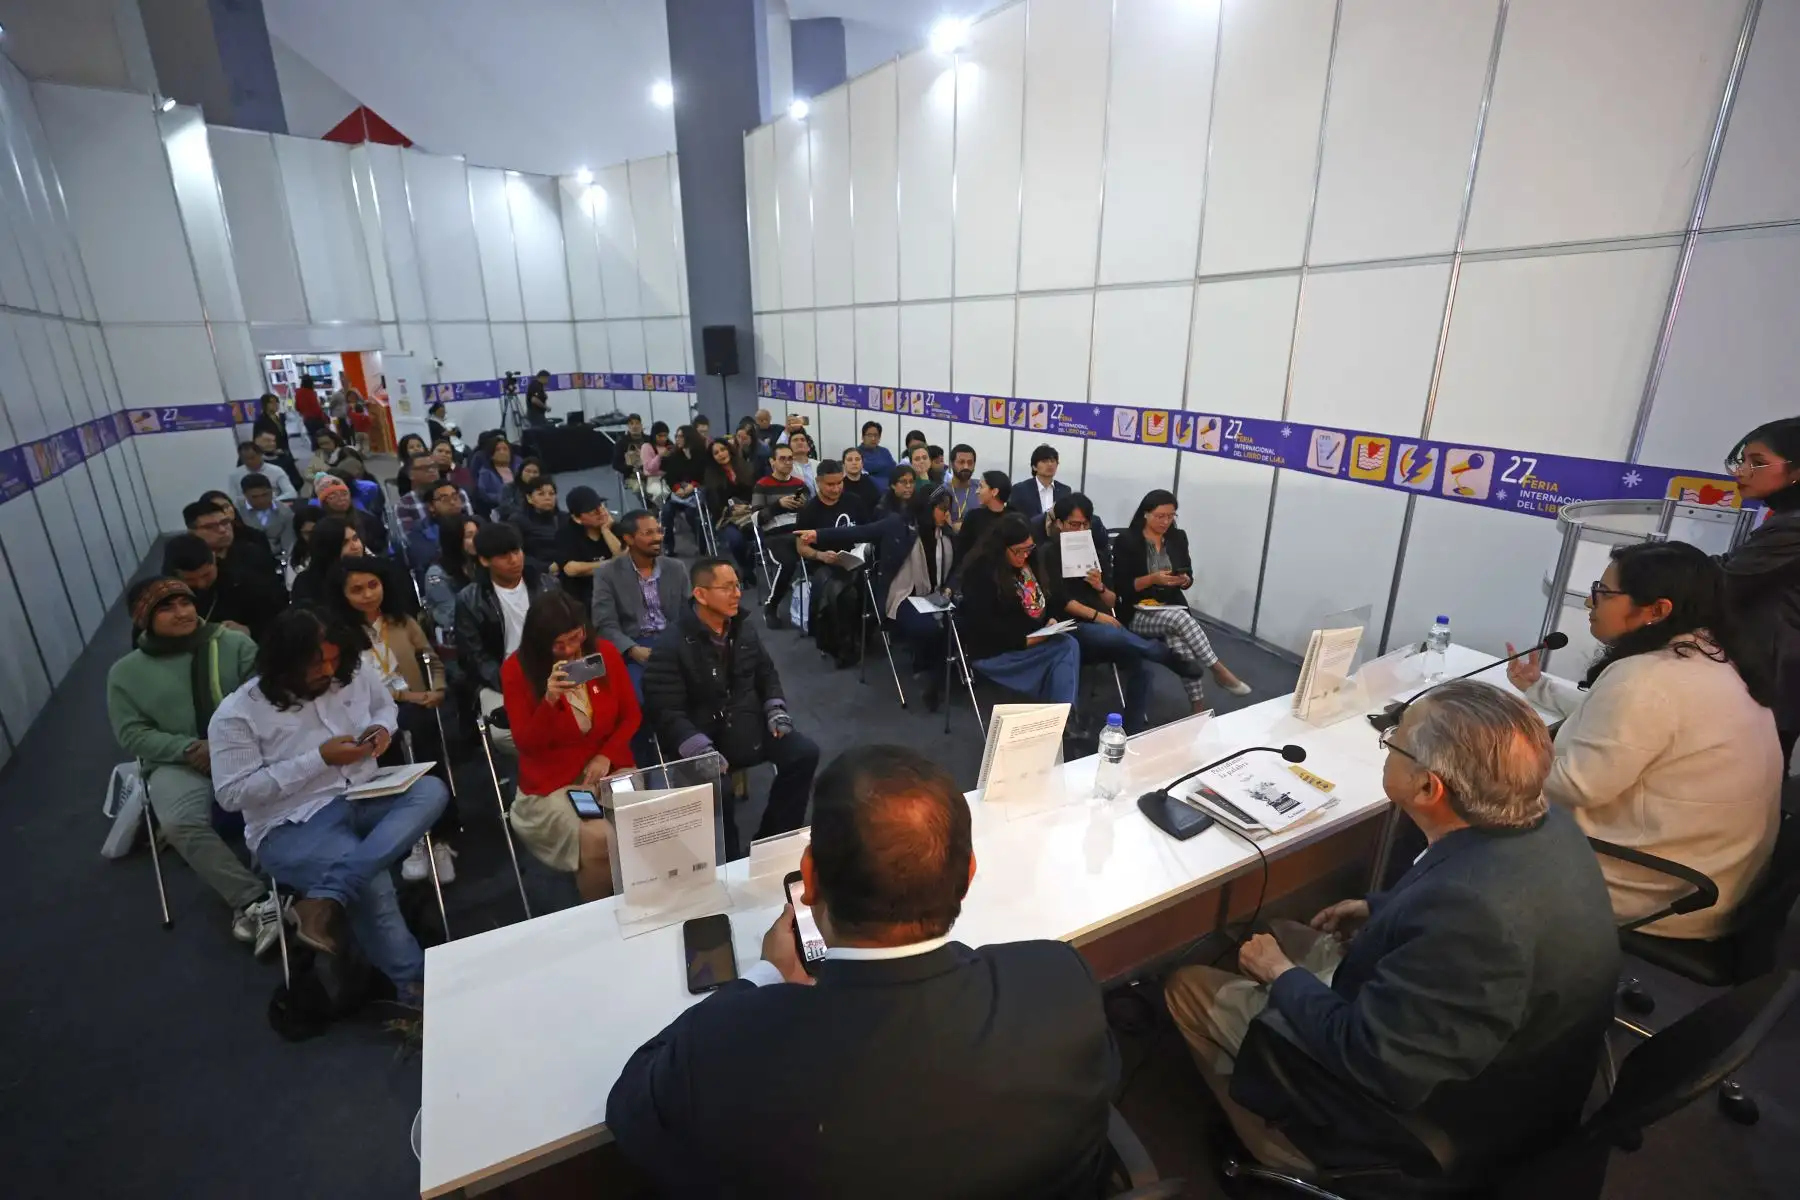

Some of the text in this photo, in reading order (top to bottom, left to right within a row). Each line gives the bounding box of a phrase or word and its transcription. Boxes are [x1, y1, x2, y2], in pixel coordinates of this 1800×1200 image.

[926, 393, 935, 406] 27
[163, 408, 178, 421] 27
[1051, 403, 1063, 419] 27
[1224, 419, 1243, 439] 27
[1234, 443, 1275, 455] INTERNACIONAL
[1261, 454, 1269, 462] DE
[1500, 455, 1538, 484] 27
[1521, 474, 1559, 493] FERIA
[1517, 500, 1559, 513] DEL LIB
